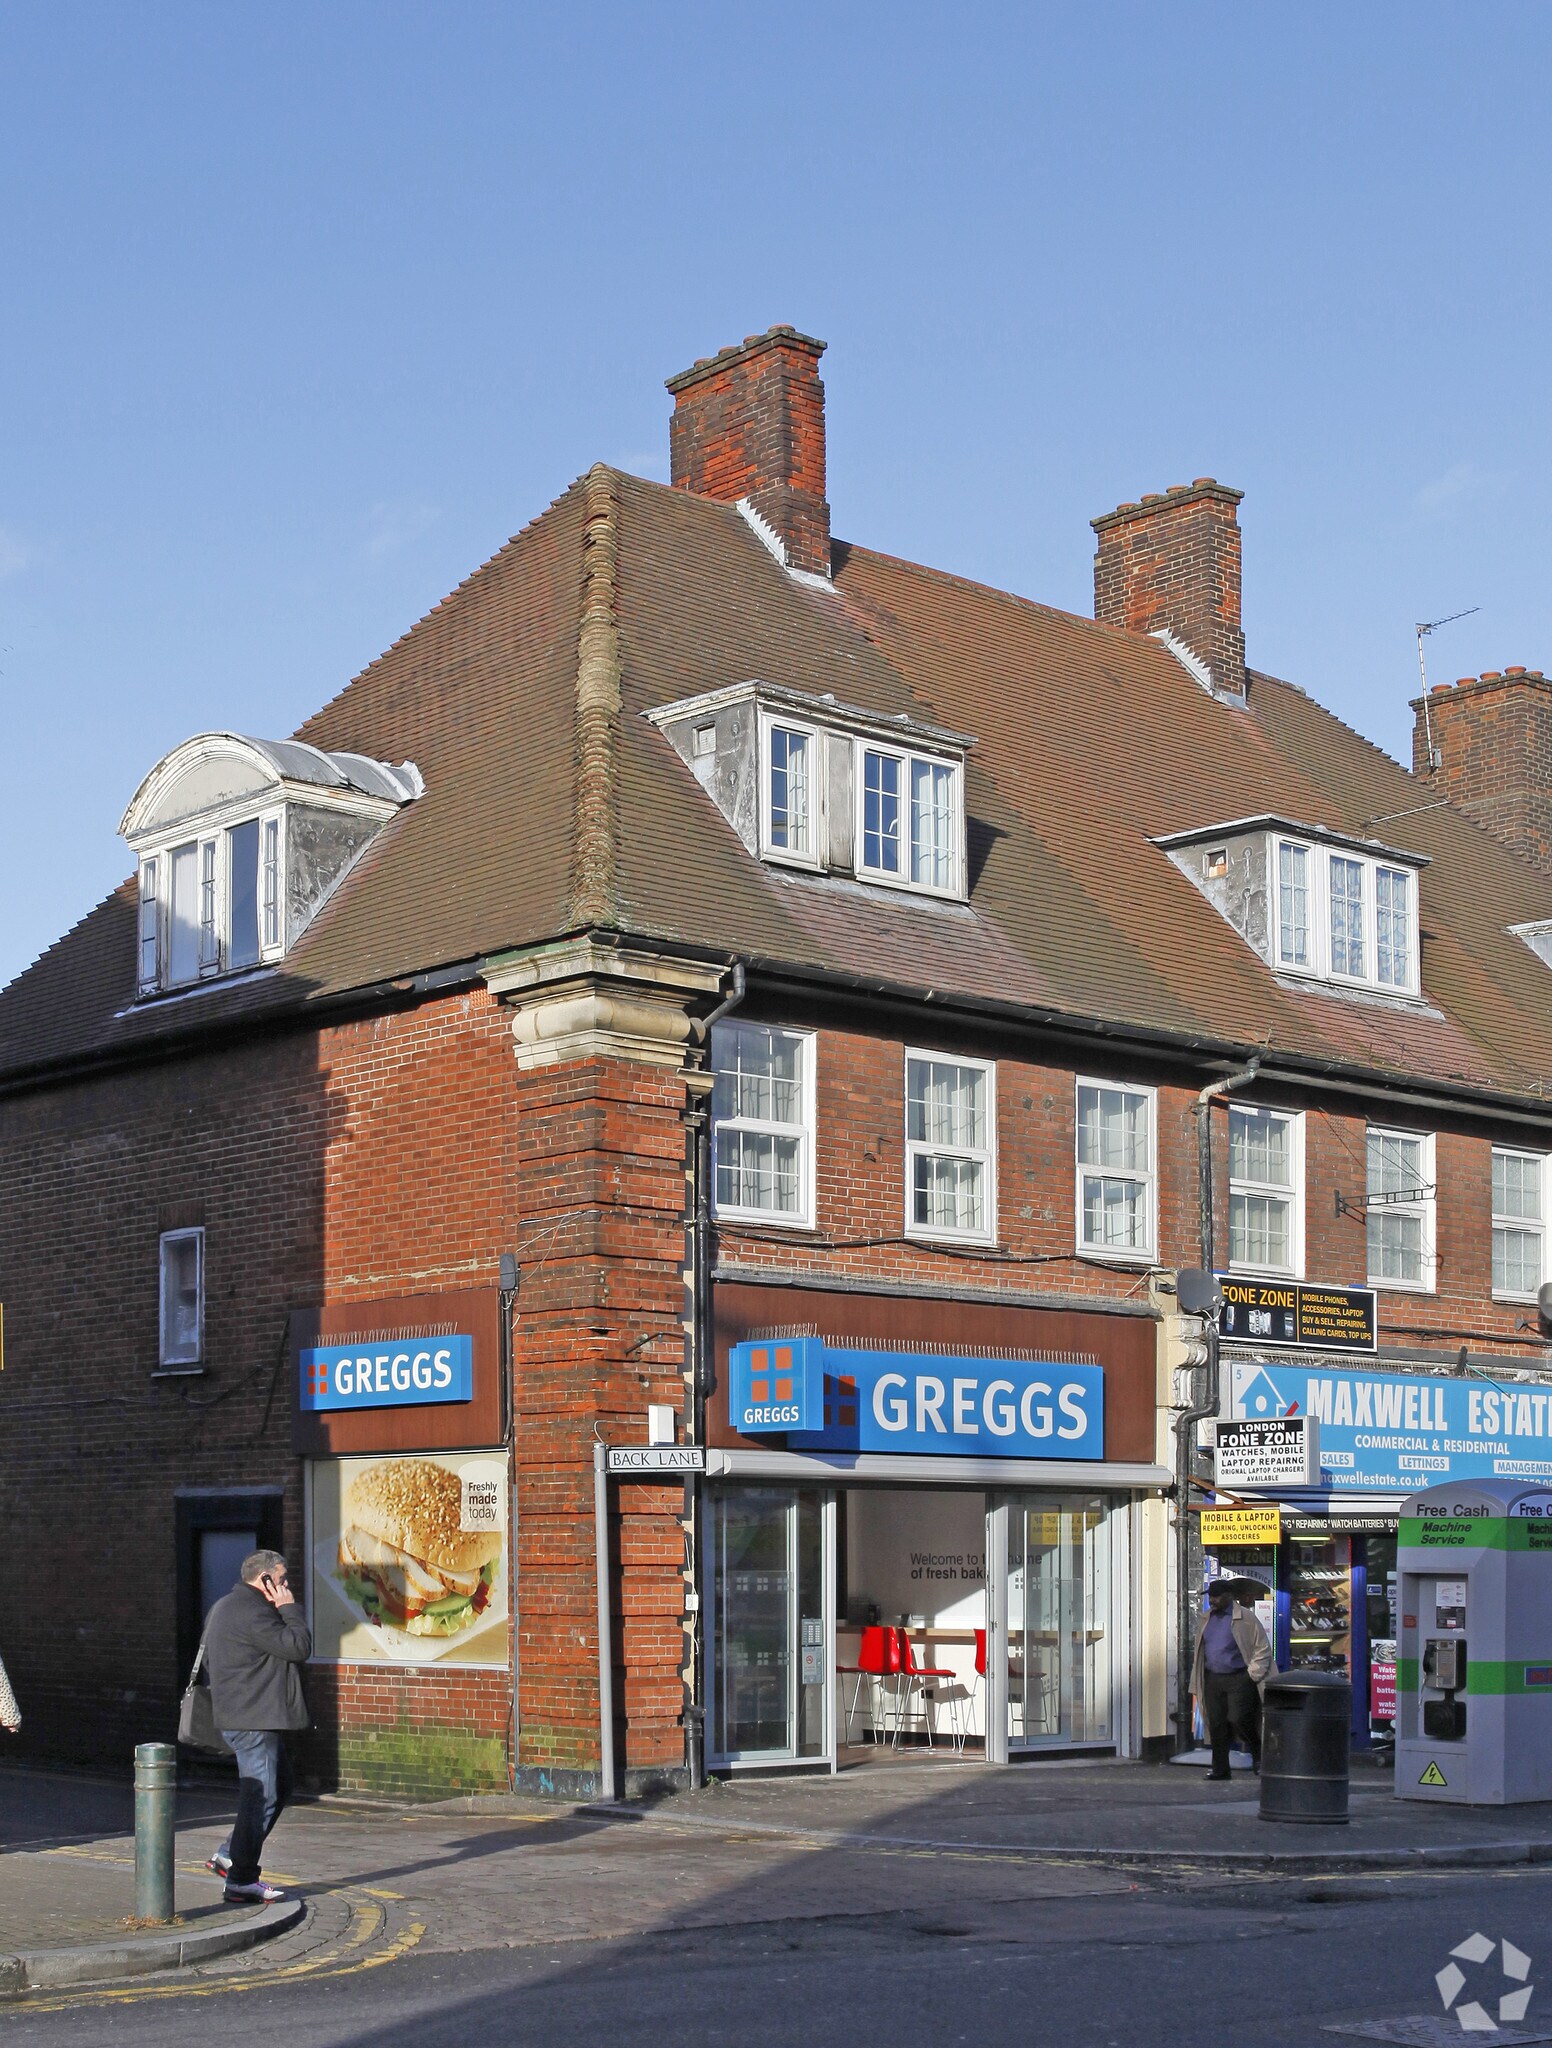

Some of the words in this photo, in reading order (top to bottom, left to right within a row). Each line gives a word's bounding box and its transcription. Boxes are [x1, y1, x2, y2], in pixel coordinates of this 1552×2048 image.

[1222, 1286, 1256, 1304] FONE
[1260, 1290, 1294, 1307] ZONE
[1302, 1294, 1324, 1302] MOBILE
[1325, 1296, 1349, 1305] PHONES,
[1302, 1305, 1342, 1316] ACCESSORIES,
[1343, 1309, 1364, 1317] LAPTOP
[1302, 1316, 1314, 1324] BUY
[1315, 1317, 1320, 1325] &
[1321, 1318, 1335, 1326] SELL,
[1337, 1320, 1366, 1329] REPAIRING
[1302, 1328, 1326, 1336] CALLING
[1328, 1330, 1348, 1339] CARDS,
[335, 1350, 452, 1395] GREGGS
[1236, 1370, 1242, 1380] 5
[872, 1373, 1088, 1439] GREGGS
[1307, 1379, 1448, 1431] MAXWELL
[744, 1406, 799, 1424] GREGGS
[1239, 1422, 1285, 1433] LONDON
[1220, 1433, 1259, 1447] FONE
[1264, 1431, 1303, 1445] ZONE
[1355, 1435, 1428, 1451] COMMERCIAL
[1432, 1439, 1440, 1451] &
[1444, 1439, 1510, 1455] RESIDENTIAL
[1222, 1448, 1267, 1457] WATCHES,
[1270, 1446, 1304, 1455] MOBILE
[613, 1452, 650, 1466] BACK
[660, 1452, 699, 1466] LANE
[1221, 1459, 1256, 1467] LAPTOP
[1260, 1457, 1304, 1466] REPAIRNG
[1321, 1454, 1349, 1465] SALES
[1402, 1457, 1445, 1469] LETTINGS
[469, 1482, 497, 1493] Freshly
[469, 1493, 497, 1504] made
[469, 1506, 497, 1521] today
[1416, 1504, 1447, 1516] Free
[1453, 1504, 1489, 1517] Cash
[1520, 1503, 1542, 1516] Free
[1204, 1514, 1233, 1522] MOBILE
[1245, 1513, 1275, 1521] LAPTOP
[1296, 1519, 1327, 1528] REPAIRING
[1331, 1519, 1353, 1528] WATCH
[1353, 1519, 1385, 1528] BATTERIES
[1421, 1522, 1472, 1532] Machine
[1421, 1534, 1465, 1544] Service
[910, 1553, 963, 1565] Welcome
[966, 1554, 979, 1565] to
[911, 1567, 923, 1579] of
[926, 1567, 958, 1579] fresh
